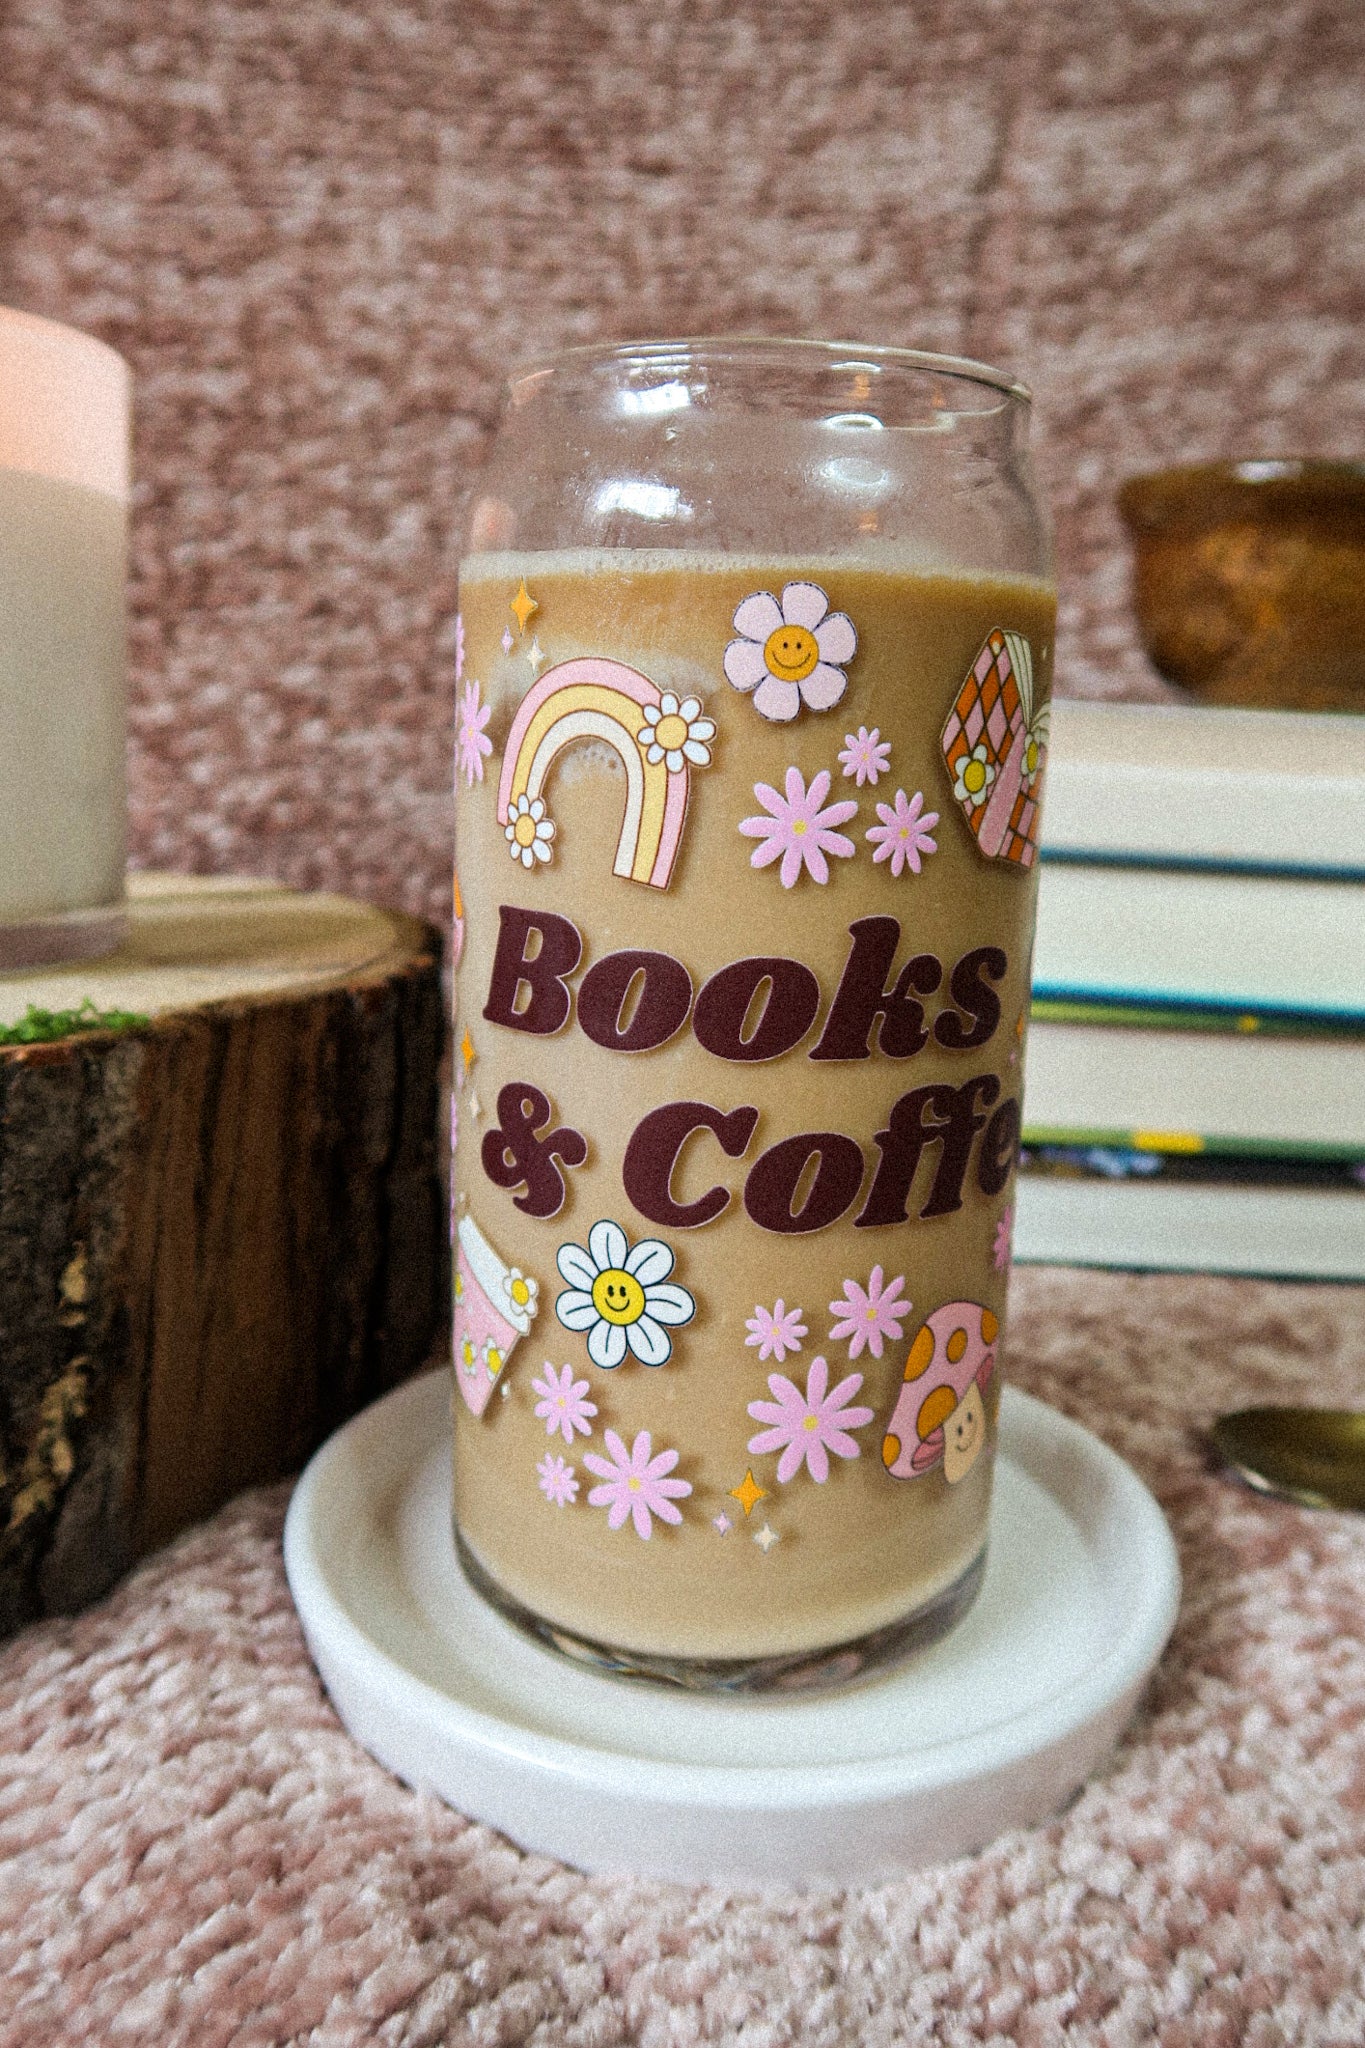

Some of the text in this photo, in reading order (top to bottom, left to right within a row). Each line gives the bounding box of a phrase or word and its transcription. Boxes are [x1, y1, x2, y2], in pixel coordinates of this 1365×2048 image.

[482, 905, 1007, 1062] Books
[481, 1074, 1020, 1235] & Coffe
